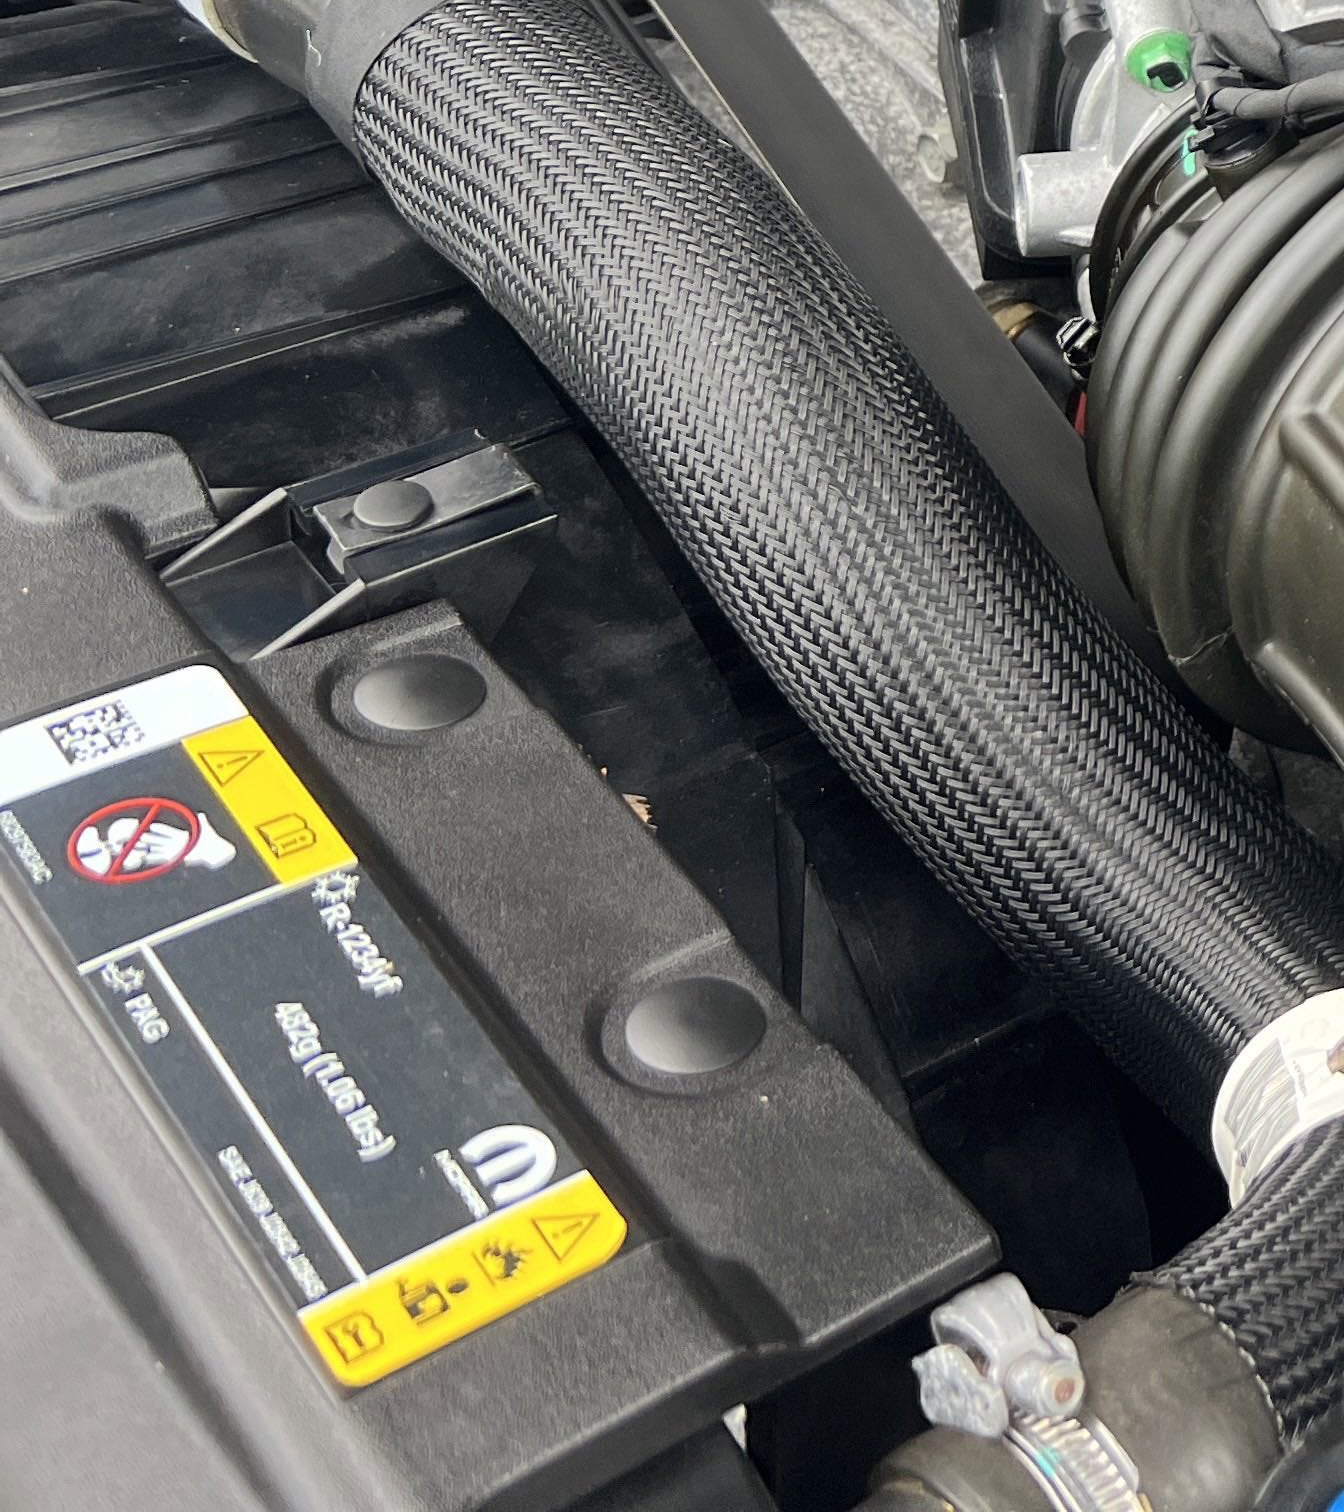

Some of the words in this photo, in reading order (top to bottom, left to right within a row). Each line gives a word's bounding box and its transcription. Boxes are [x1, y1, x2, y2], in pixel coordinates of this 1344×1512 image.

[319, 897, 403, 998] R-1234yf
[123, 994, 170, 1045] PAG
[274, 1001, 322, 1064] 482g
[343, 1103, 398, 1162] lbs)
